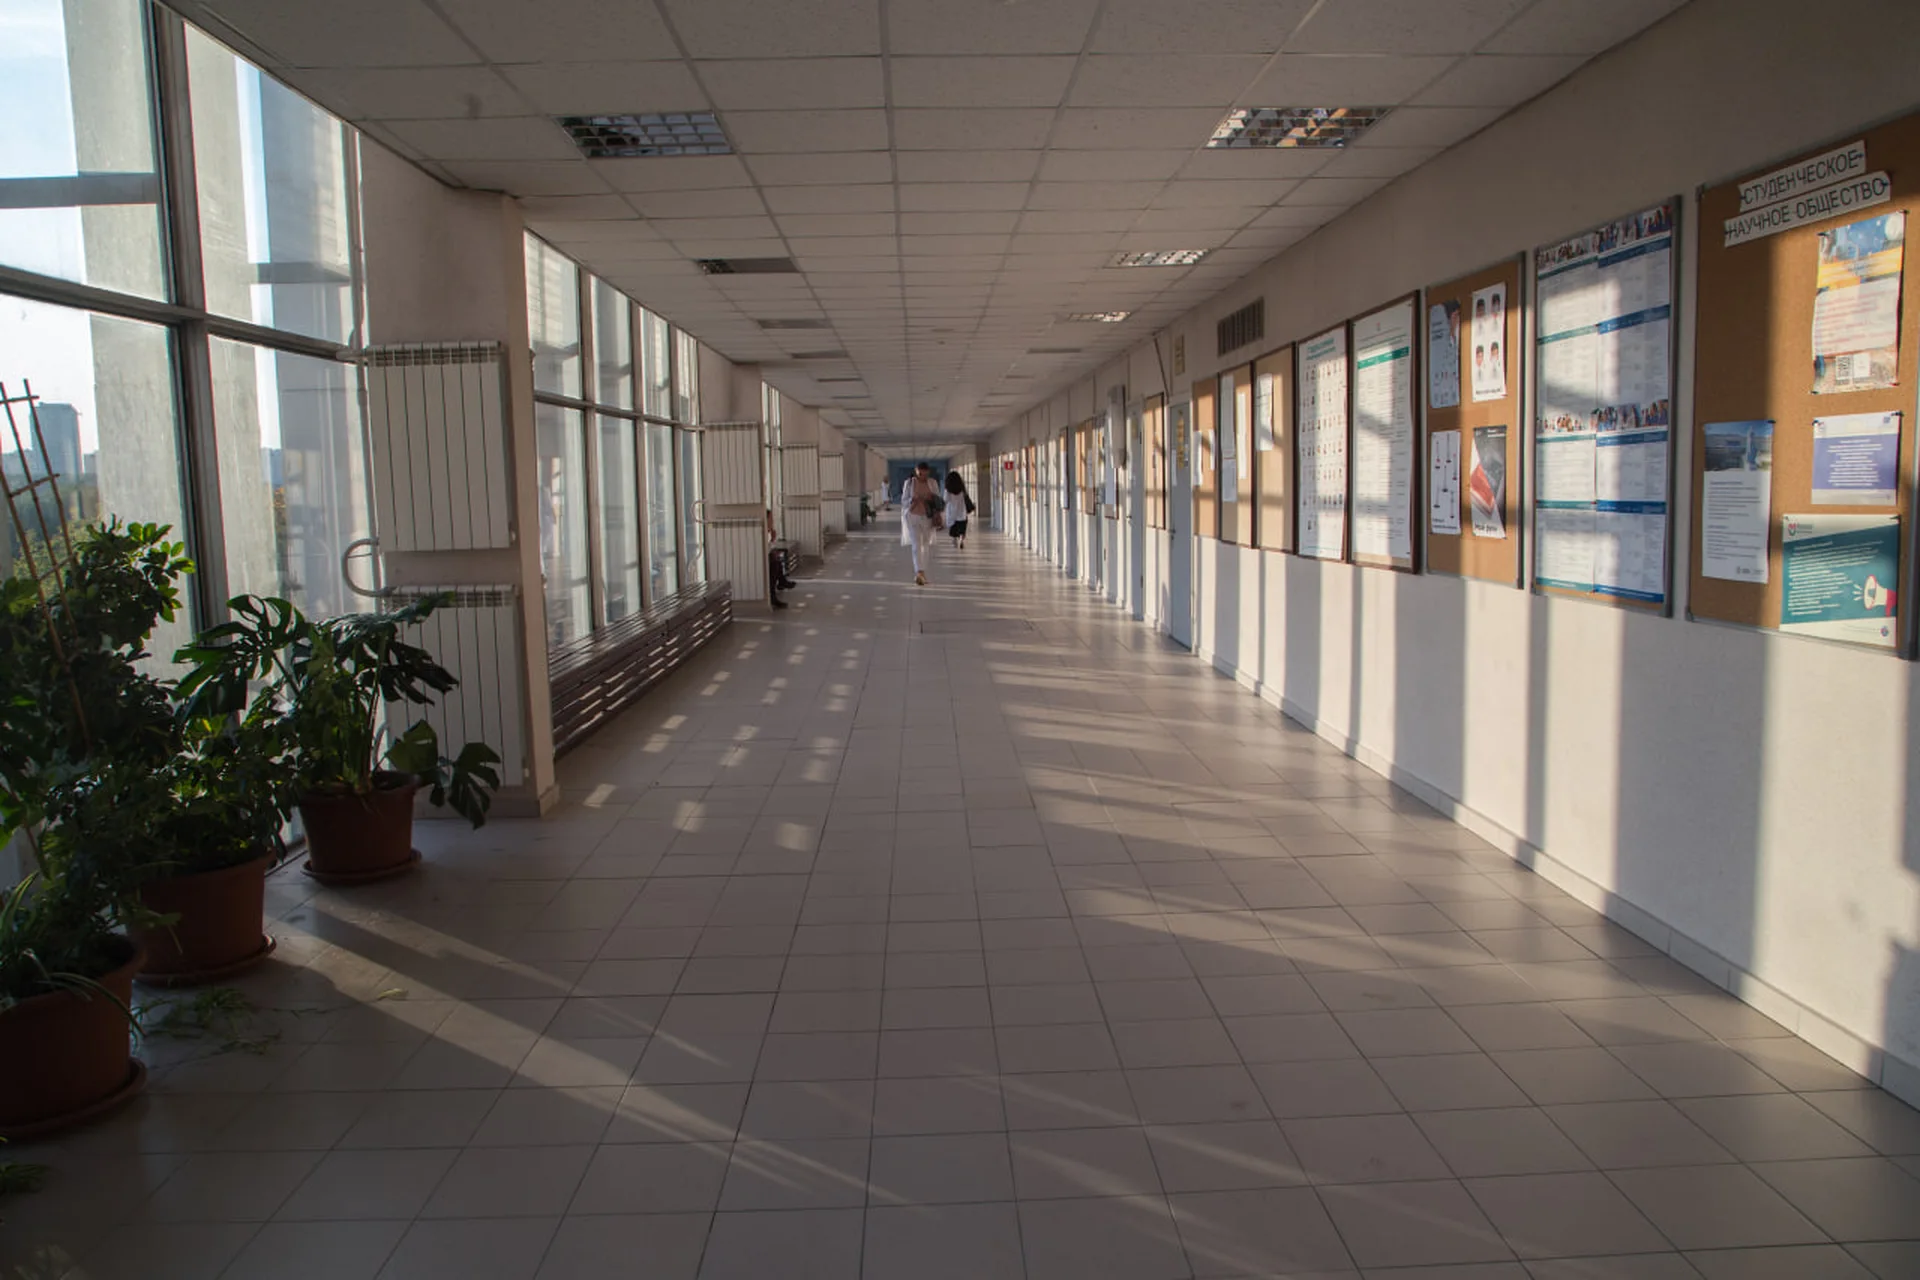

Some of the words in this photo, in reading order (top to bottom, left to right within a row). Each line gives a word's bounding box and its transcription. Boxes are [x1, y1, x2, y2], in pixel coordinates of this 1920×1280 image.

[1743, 149, 1859, 205] СТУДЕНЧЕСКОЕ
[1727, 205, 1791, 240] НАУЧНОЕ
[1796, 177, 1887, 219] ОБЩЕСТВО
